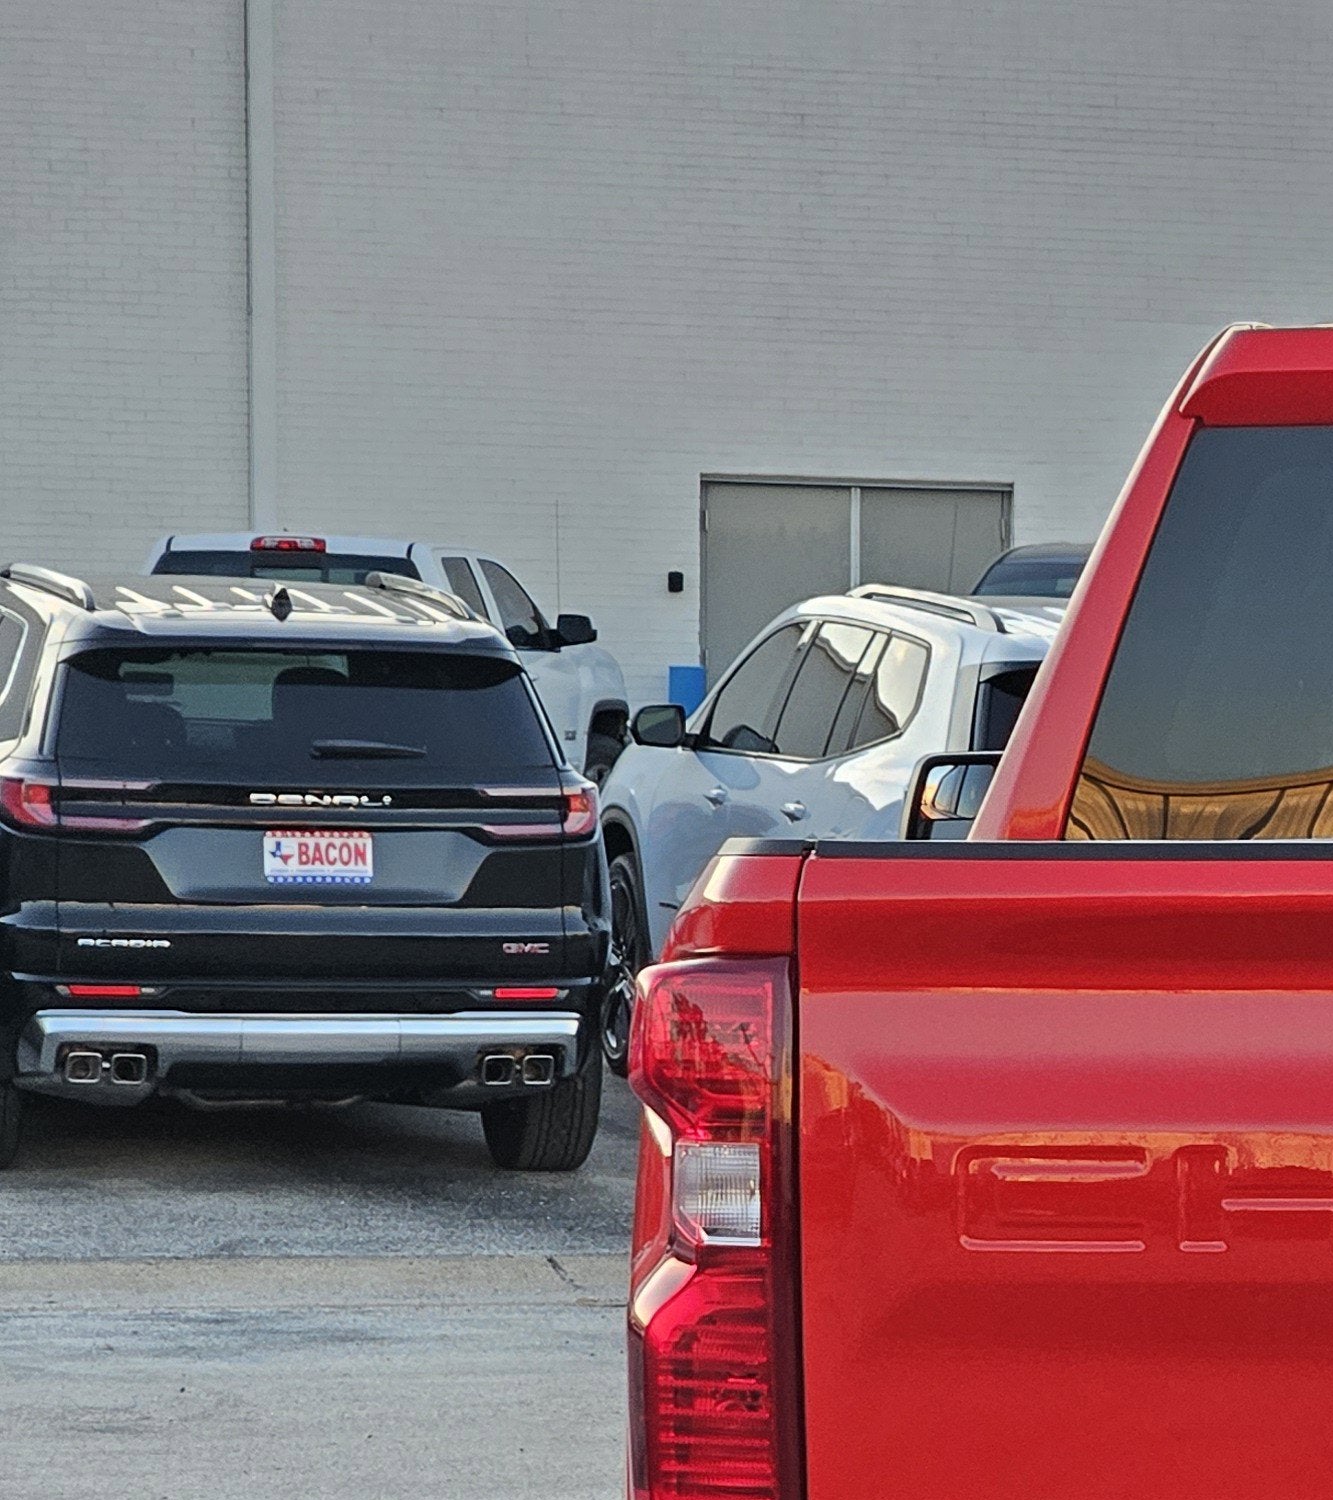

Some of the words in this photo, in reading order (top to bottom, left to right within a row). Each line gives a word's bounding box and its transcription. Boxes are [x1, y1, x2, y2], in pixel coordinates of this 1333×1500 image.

[249, 793, 392, 806] DENALI
[297, 841, 367, 866] BACON
[77, 938, 171, 948] ACADIA
[502, 942, 550, 954] GMC
